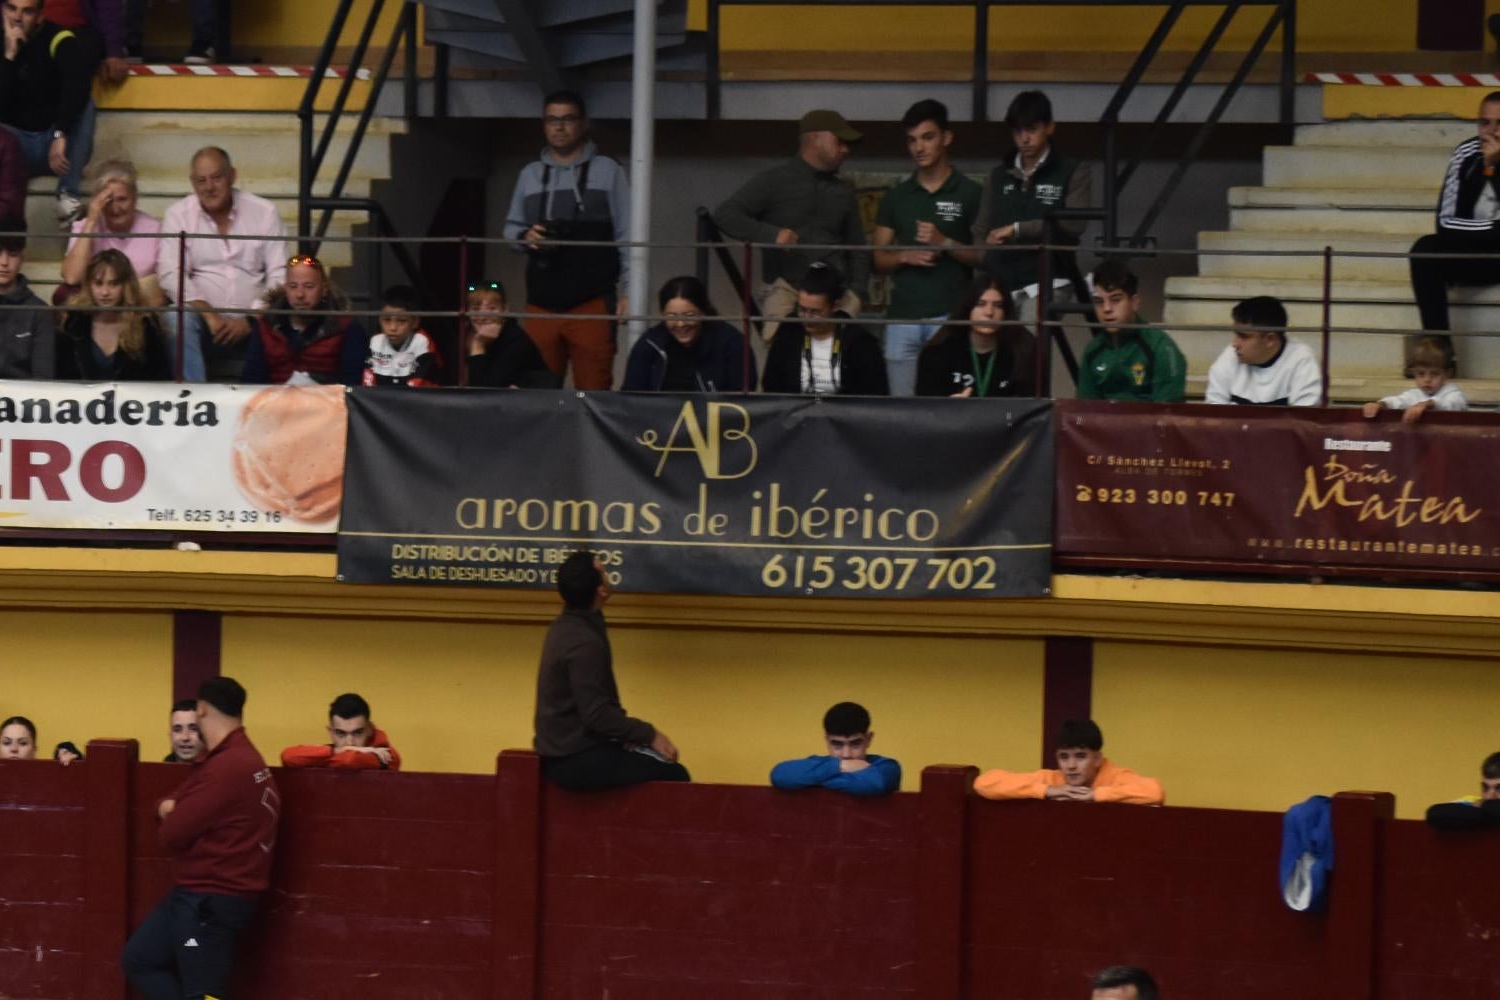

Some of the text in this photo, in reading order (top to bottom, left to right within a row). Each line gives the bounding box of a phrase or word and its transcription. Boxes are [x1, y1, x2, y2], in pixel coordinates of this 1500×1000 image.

[636, 400, 758, 479] AB
[1323, 454, 1397, 484] Doña
[1097, 488, 1236, 507] 923 300 747
[1293, 464, 1483, 528] Matea
[147, 508, 282, 524] Telf. 625 34 39 16
[456, 482, 940, 542] aromas de ibérico
[392, 543, 623, 566] DISTRIBUCIÓN DE IBÉOS
[392, 564, 430, 580] SALA
[429, 566, 447, 580] DE
[449, 567, 537, 583] DESHUESADO
[761, 554, 997, 591] 615 307 702
